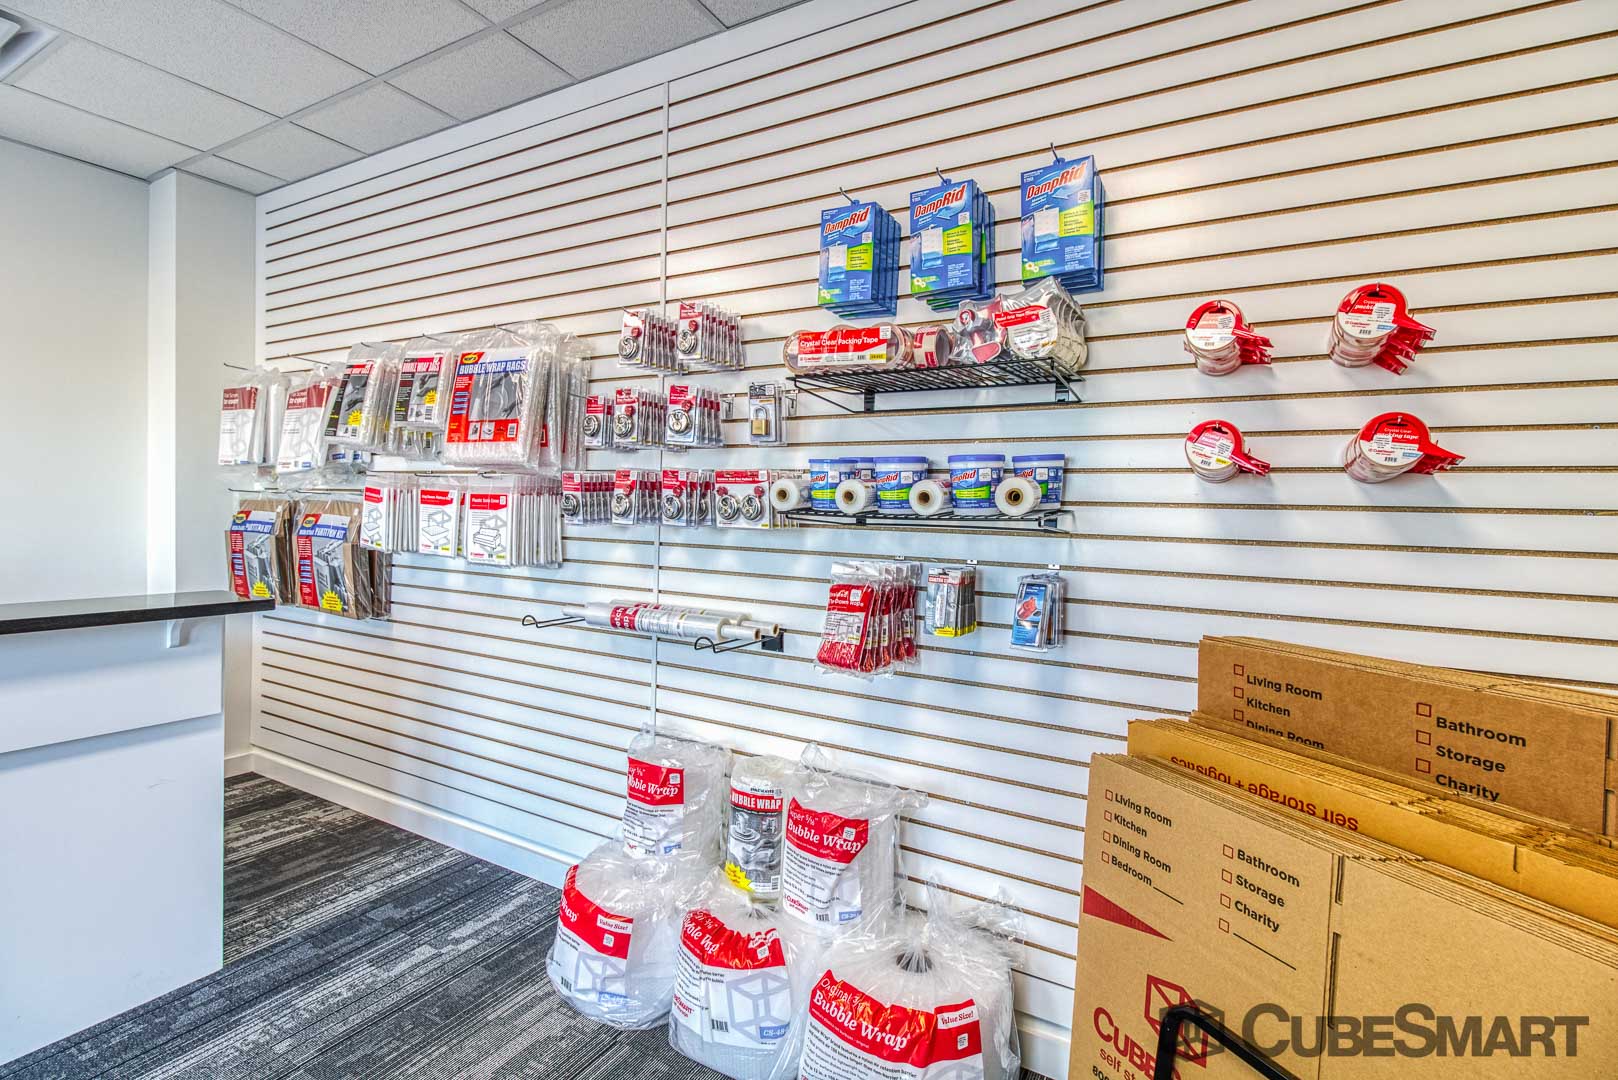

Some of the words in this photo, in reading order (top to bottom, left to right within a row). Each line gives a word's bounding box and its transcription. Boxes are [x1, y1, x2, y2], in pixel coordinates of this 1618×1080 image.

[1026, 161, 1087, 201] DampRid
[913, 183, 967, 220] DampRid
[824, 206, 871, 235] DampRid
[800, 339, 820, 348] Crystal
[838, 338, 862, 346] Packing
[459, 363, 486, 375] BUBBLE
[486, 361, 506, 373] WRAP
[506, 359, 527, 371] BAGS
[1246, 674, 1282, 693] Living
[1285, 683, 1323, 701] Room
[1246, 697, 1291, 717] Kitchen
[1287, 731, 1325, 750] Room
[1436, 716, 1527, 748] Bathroom
[1435, 745, 1506, 773] Storage
[647, 782, 679, 797] Wrap
[731, 793, 756, 808] BUBBLE
[756, 798, 781, 809] WRAP
[1435, 773, 1500, 802] Charity
[1115, 792, 1142, 814] Living
[1144, 806, 1172, 827] Room
[787, 819, 820, 843] Bubble
[823, 834, 861, 854] Wrap
[1114, 812, 1147, 838] Kitchen
[1112, 834, 1141, 858] Dining
[1143, 851, 1171, 873] Room
[1237, 848, 1300, 887] Bathroom
[1111, 855, 1152, 886] Bedroom
[1235, 874, 1286, 908] Storage
[599, 918, 613, 929] Value
[1234, 900, 1280, 933] Charity
[820, 978, 850, 1003] Original
[812, 989, 858, 1031] Bubble
[861, 1022, 907, 1052] Wrap
[941, 1016, 958, 1026] Value
[958, 1010, 974, 1021] Size!
[1099, 1047, 1122, 1073] self
